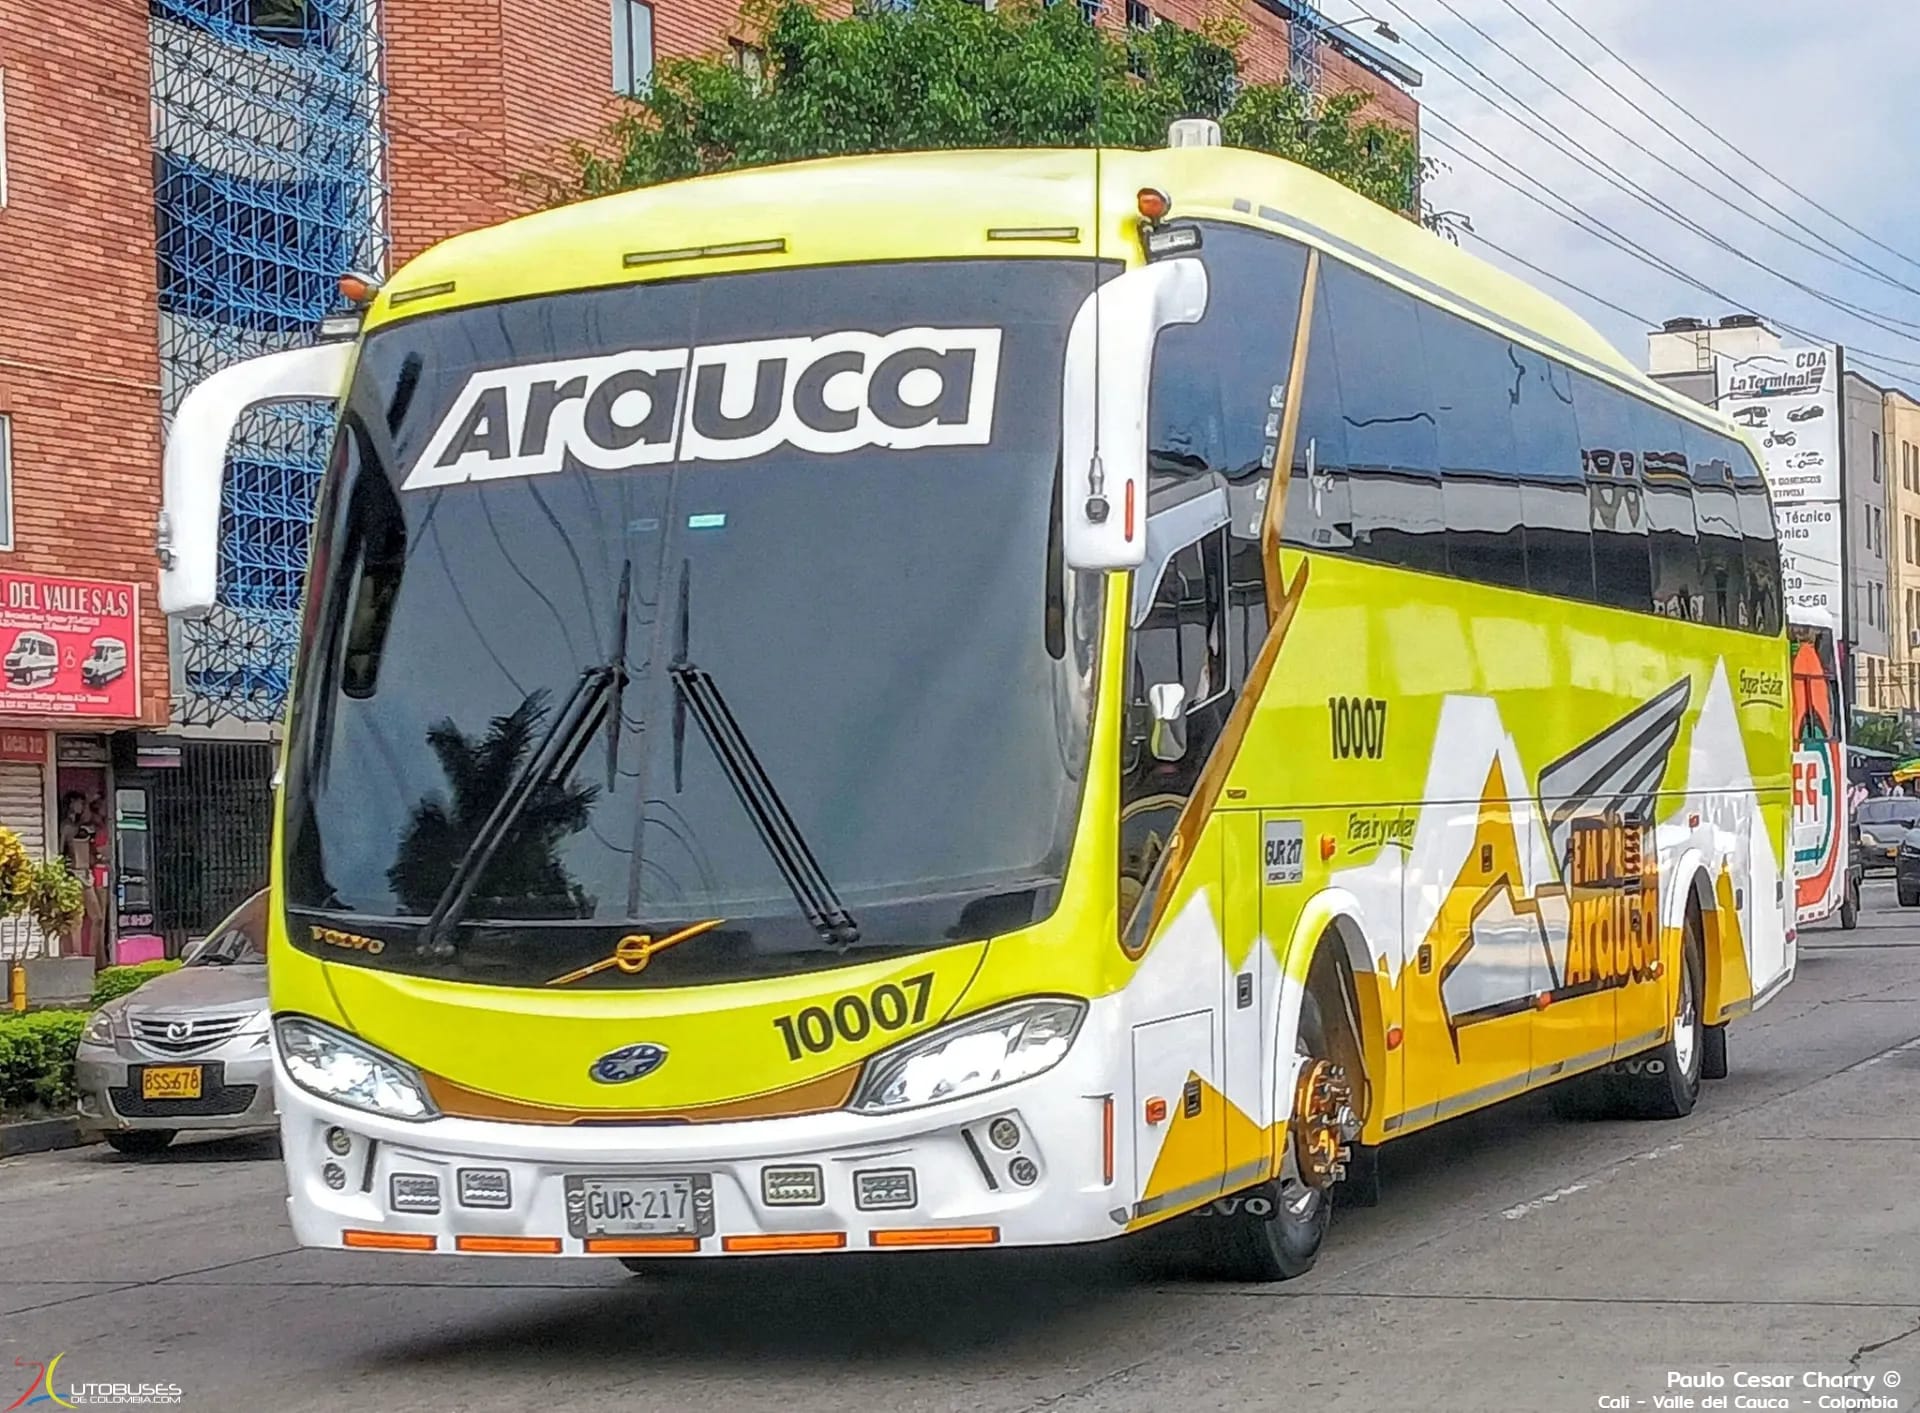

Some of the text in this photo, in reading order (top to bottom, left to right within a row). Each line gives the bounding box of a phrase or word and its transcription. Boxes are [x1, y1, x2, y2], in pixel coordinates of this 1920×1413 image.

[1795, 351, 1827, 369] CDA
[428, 343, 981, 471] Arauca
[1785, 508, 1832, 524] Técnico
[9, 581, 41, 610] DEL
[43, 584, 89, 614] VALLE
[1328, 696, 1387, 760] 10007
[309, 925, 385, 954] VOLVO
[1567, 889, 1660, 987] Arauca
[773, 971, 937, 1061] 10007
[587, 1187, 689, 1220] GUR-217
